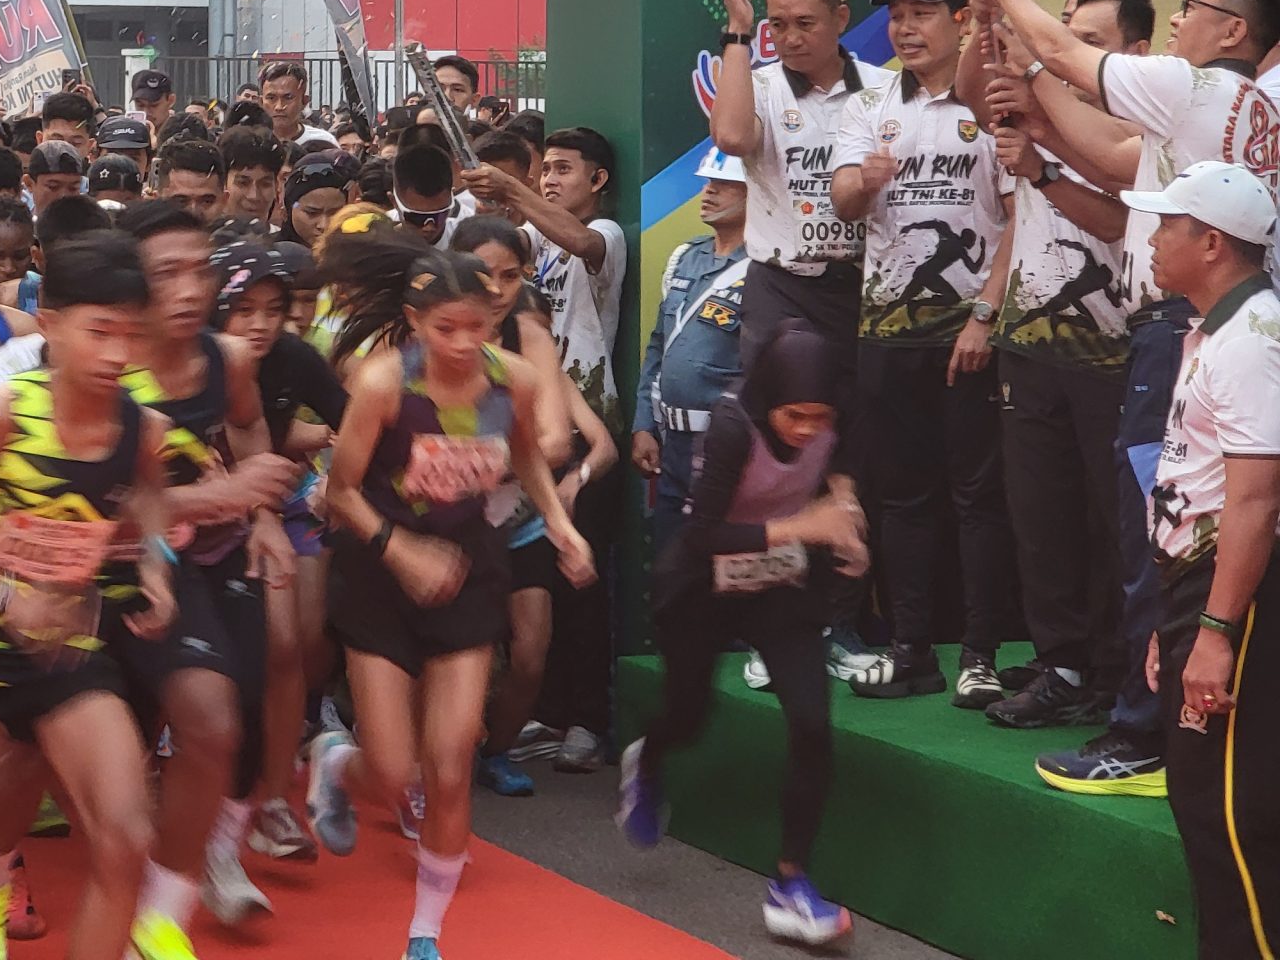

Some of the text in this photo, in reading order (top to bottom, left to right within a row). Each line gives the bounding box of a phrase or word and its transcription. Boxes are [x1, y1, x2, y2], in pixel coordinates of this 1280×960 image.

[786, 144, 833, 174] FUN
[893, 153, 978, 181] UN RUN
[788, 179, 818, 190] HUT
[938, 188, 975, 201] KE-81
[801, 221, 867, 242] 00980
